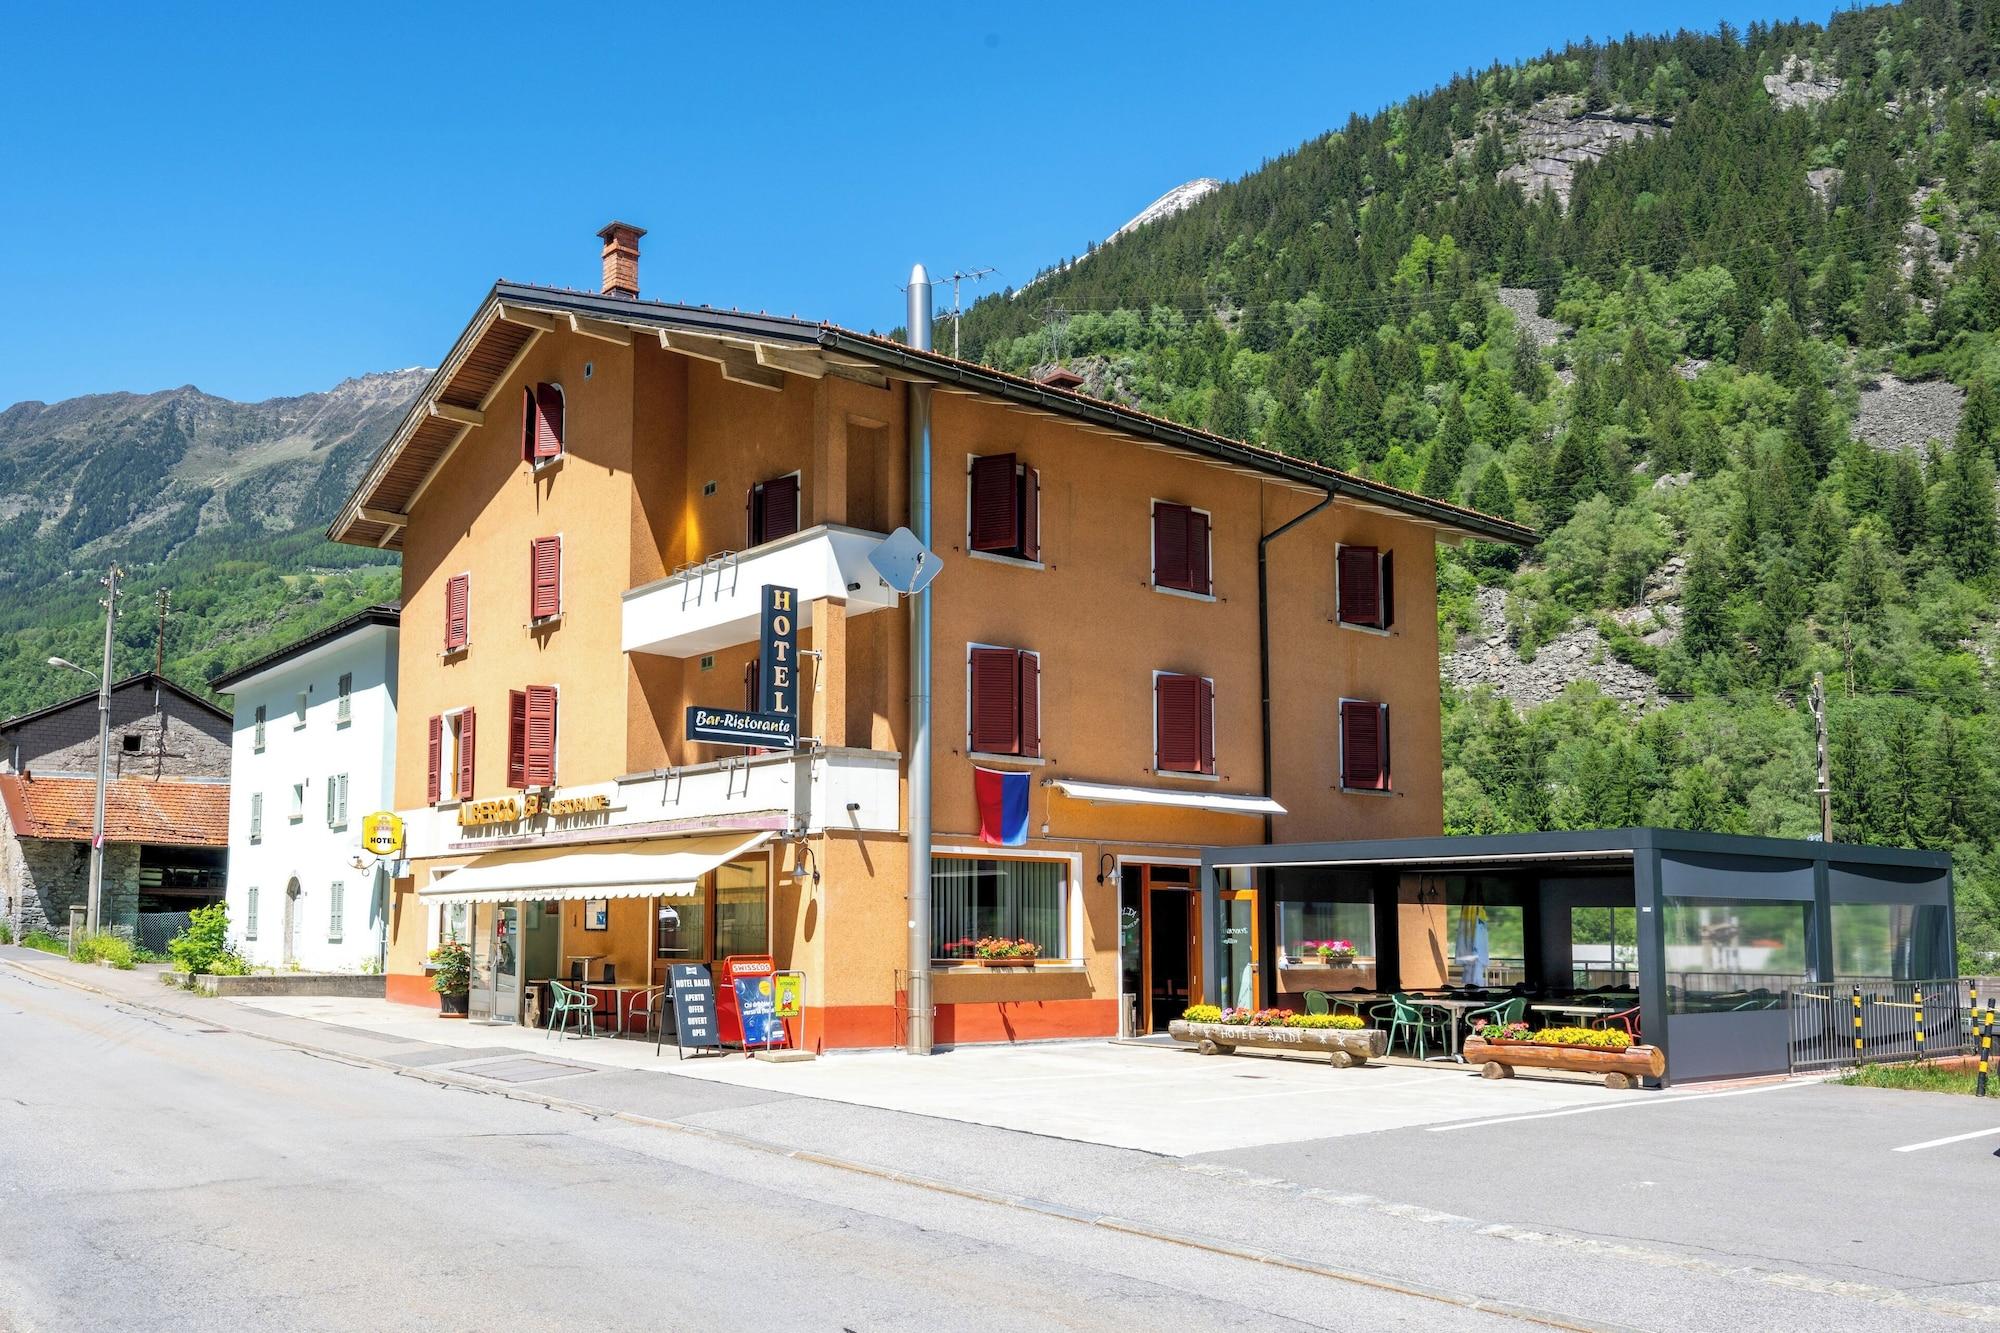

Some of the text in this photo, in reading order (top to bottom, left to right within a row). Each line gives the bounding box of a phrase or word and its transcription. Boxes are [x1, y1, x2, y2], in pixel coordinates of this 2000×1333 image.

[773, 590, 791, 713] HOTEL
[695, 710, 790, 732] Bar-Ristorante
[677, 978, 711, 988] HOTEL BALDI
[685, 994, 705, 1002] APERTO
[688, 1017, 707, 1025] OUVERT
[692, 1029, 706, 1037] OPEN
[1221, 1030, 1303, 1044] HOTEL BALDI
